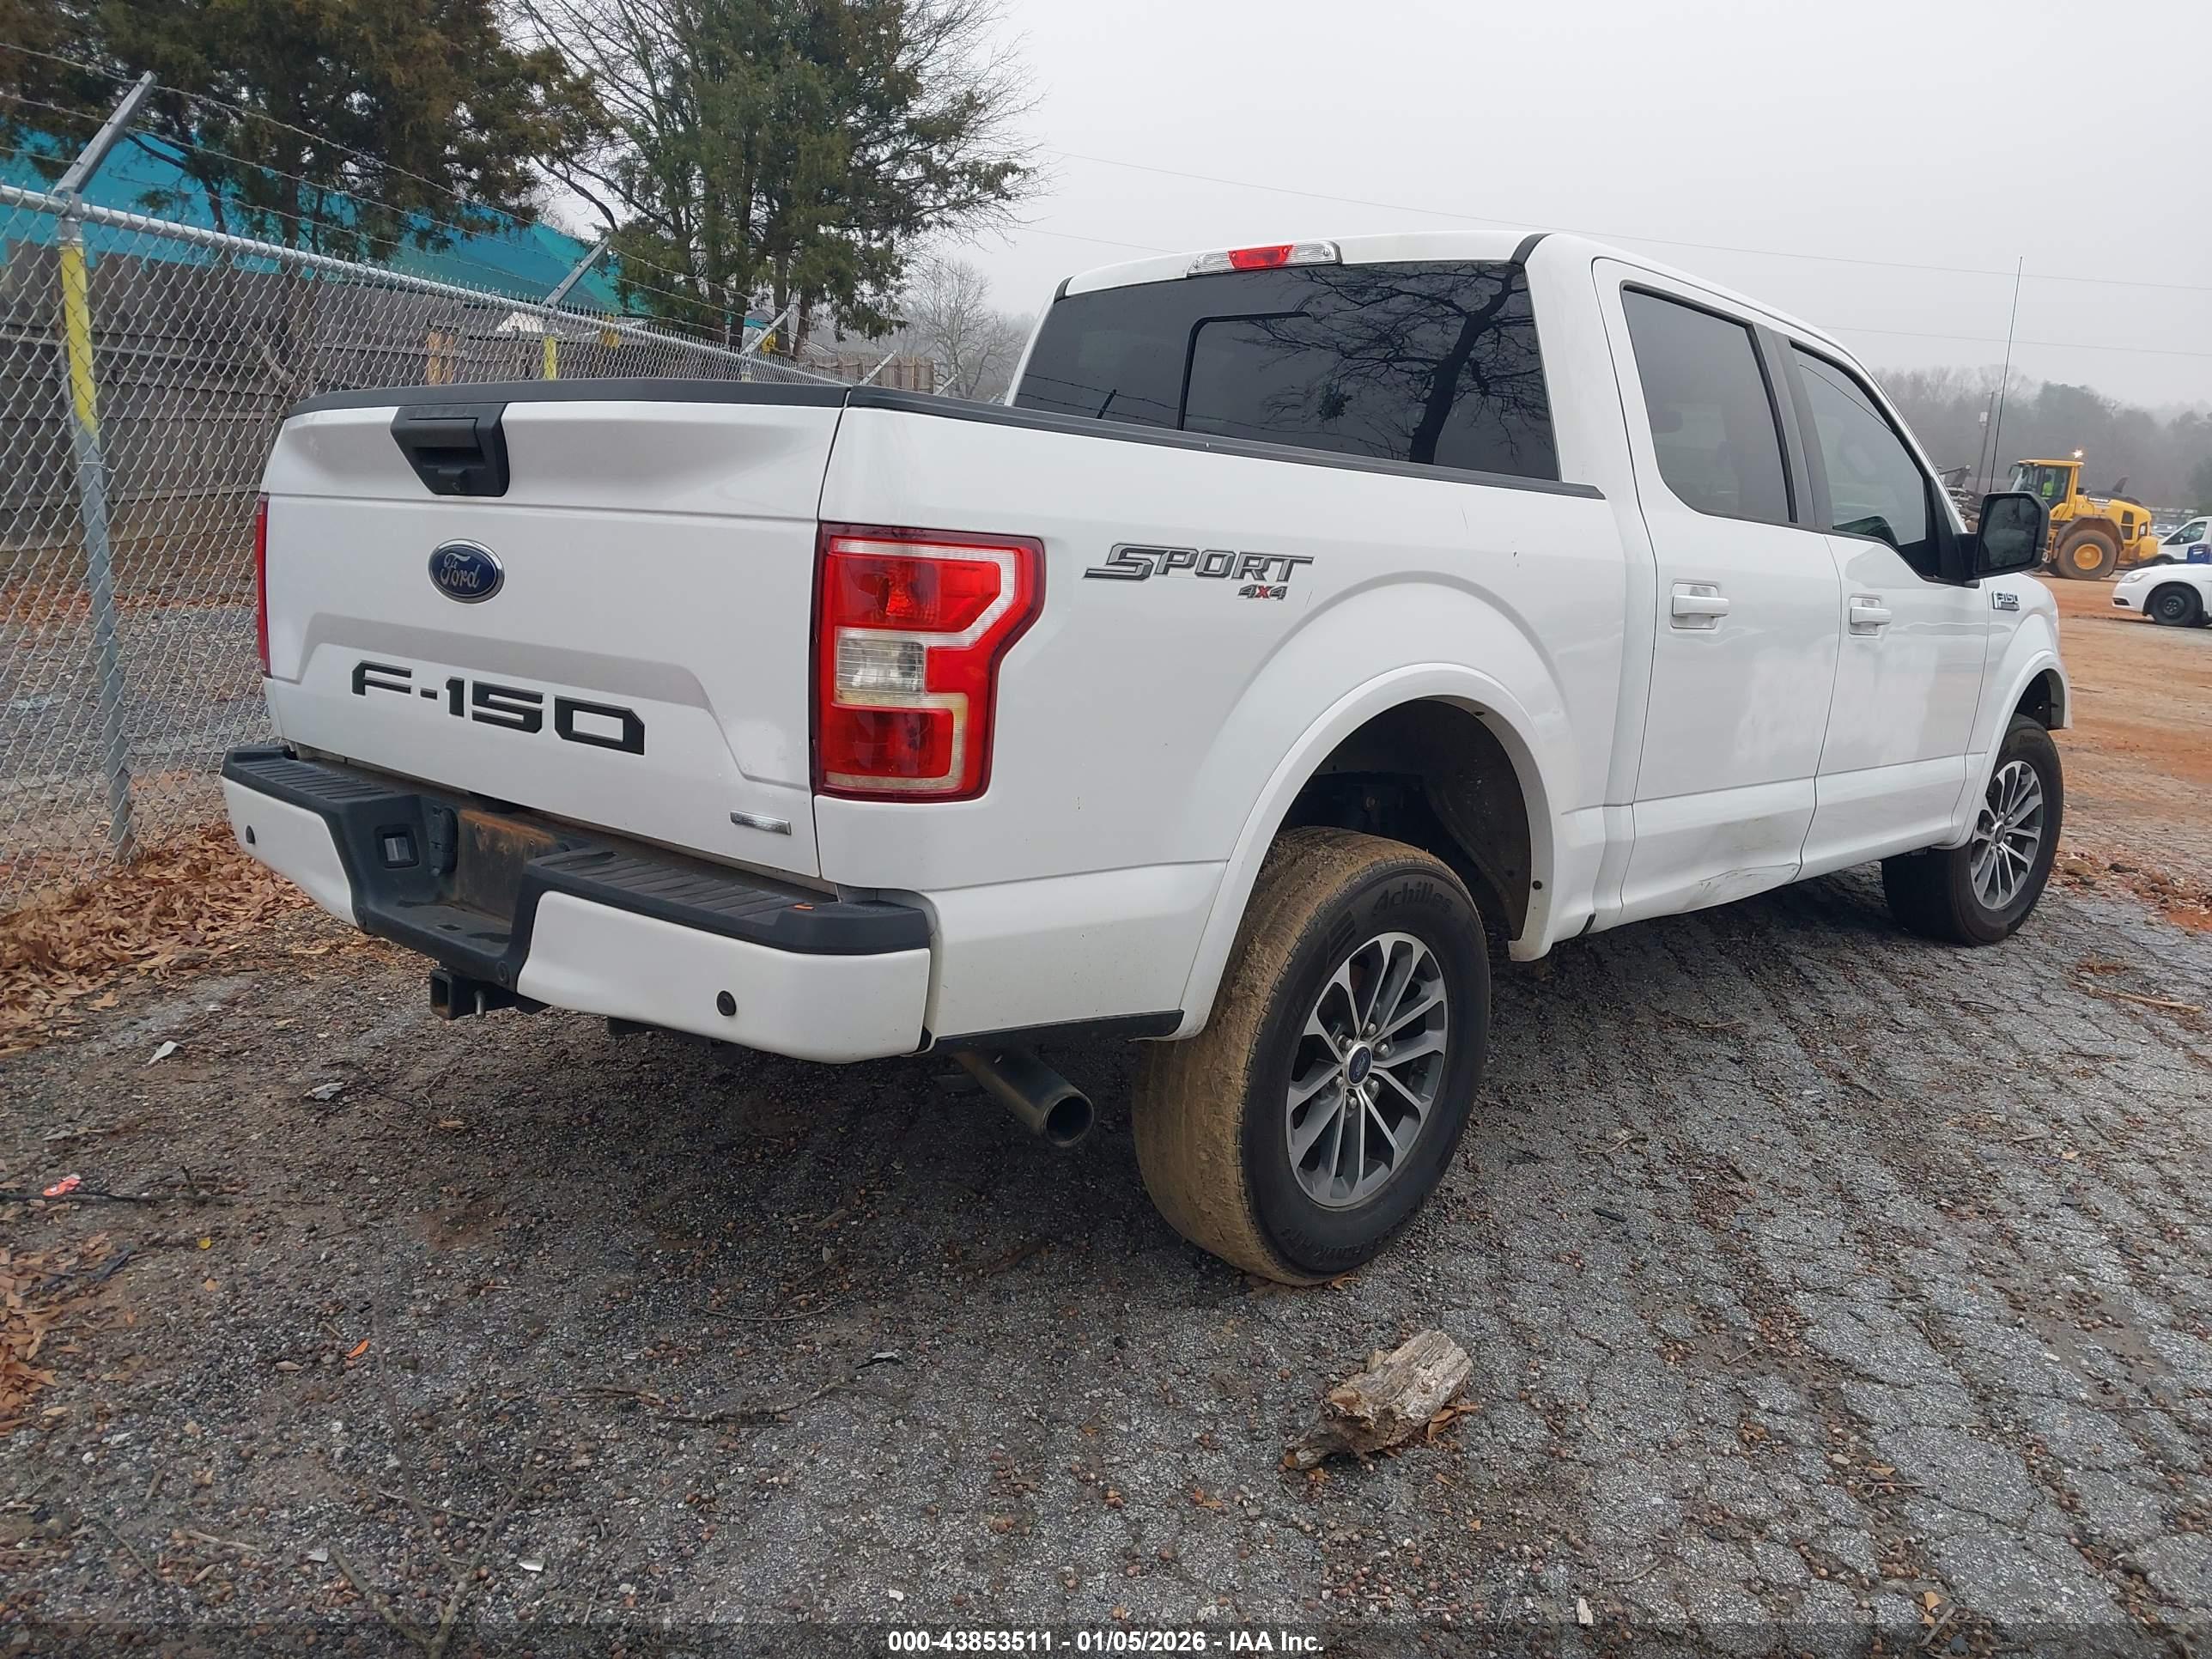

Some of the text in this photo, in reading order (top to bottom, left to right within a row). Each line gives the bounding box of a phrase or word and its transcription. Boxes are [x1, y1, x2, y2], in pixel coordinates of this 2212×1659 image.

[440, 552, 481, 589] Ford
[1083, 542, 1315, 582] SPORT
[350, 659, 646, 756] F-150
[1370, 881, 1454, 916] Achilles
